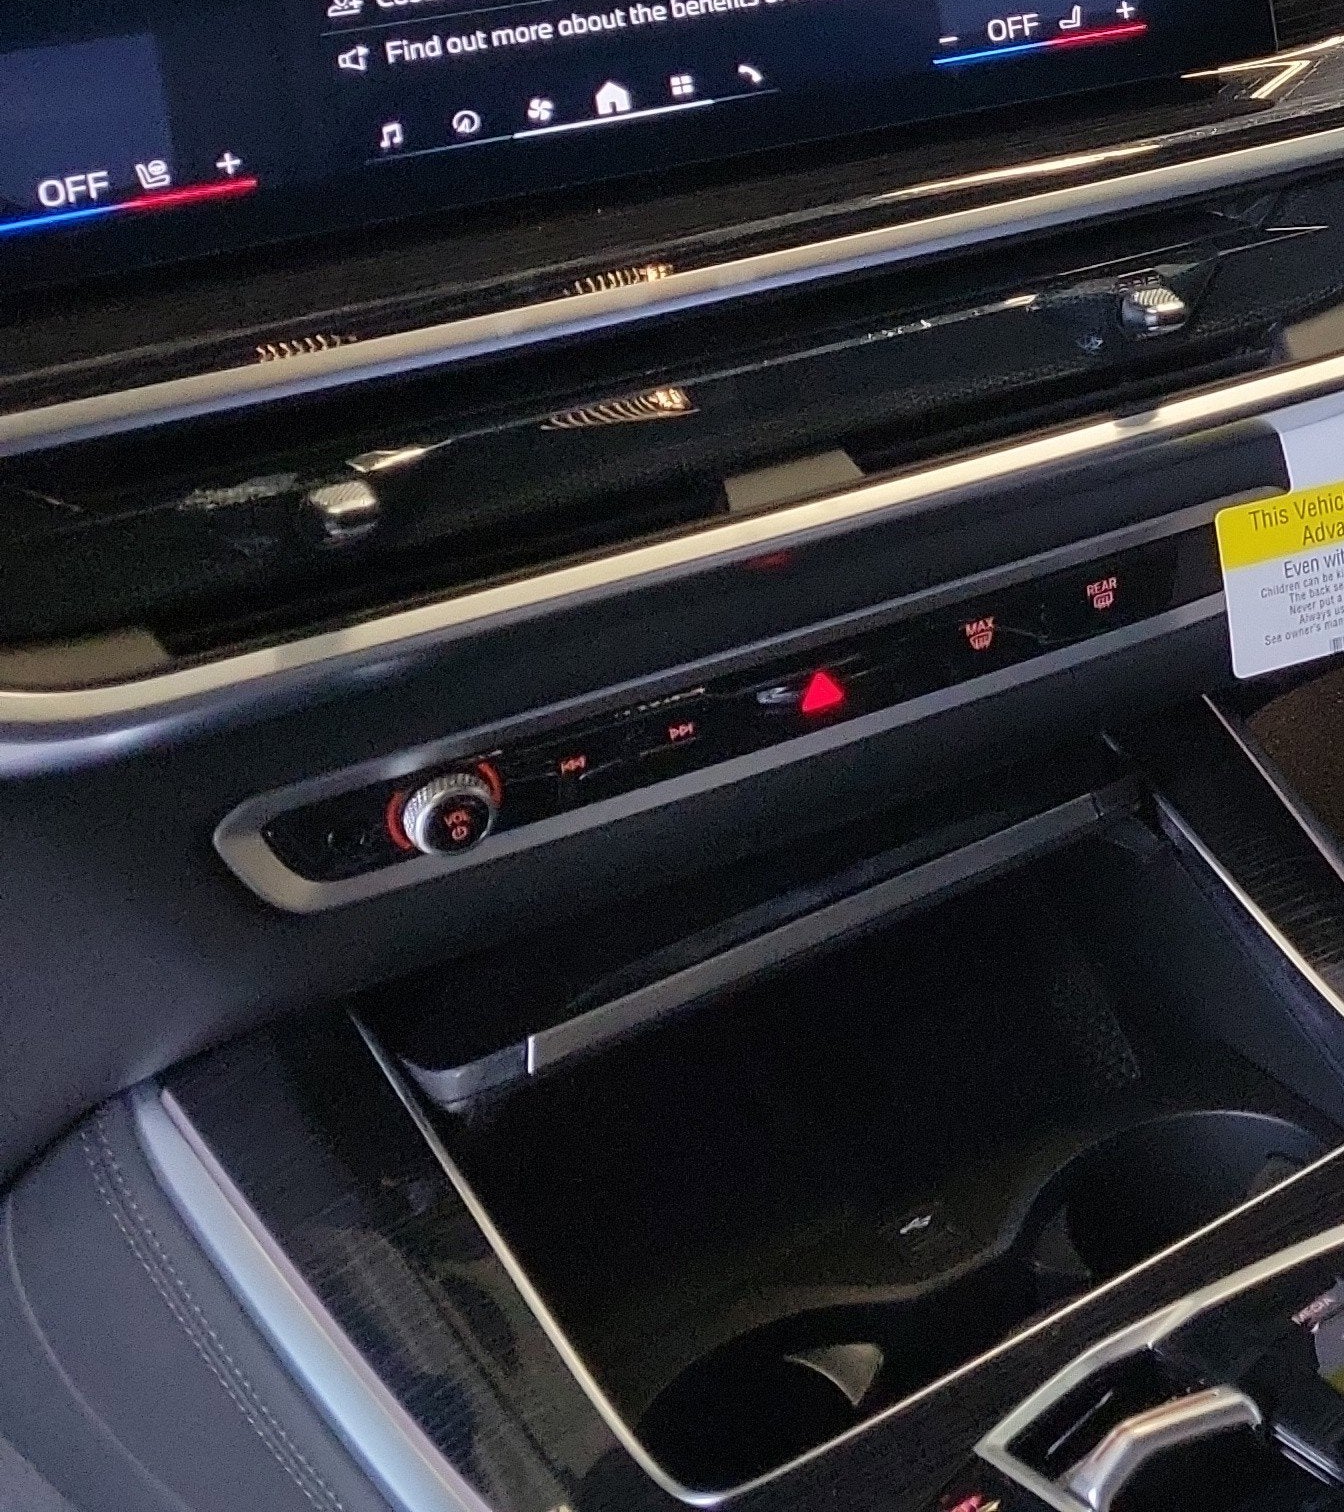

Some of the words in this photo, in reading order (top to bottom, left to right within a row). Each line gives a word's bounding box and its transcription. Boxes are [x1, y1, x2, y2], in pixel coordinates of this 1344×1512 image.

[385, 35, 443, 64] Find
[446, 30, 487, 53] out
[491, 21, 554, 47] more
[557, 9, 626, 37] about
[629, 1, 667, 26] the
[987, 13, 1040, 42] OFF
[37, 171, 109, 207] OFF
[1249, 505, 1289, 531] This
[1283, 557, 1319, 579] Even
[1086, 576, 1117, 597] REAR
[1261, 581, 1300, 599] Children
[1303, 577, 1319, 587] can
[1322, 572, 1333, 583] be
[1289, 591, 1306, 603] The
[1309, 585, 1330, 598] back
[1289, 600, 1316, 615] Never
[1320, 596, 1334, 608] put
[1300, 608, 1331, 625] Always
[965, 616, 995, 636] MAX
[1264, 633, 1282, 645] See
[1285, 622, 1321, 640] owner's
[1291, 1296, 1336, 1326] MEDIA
